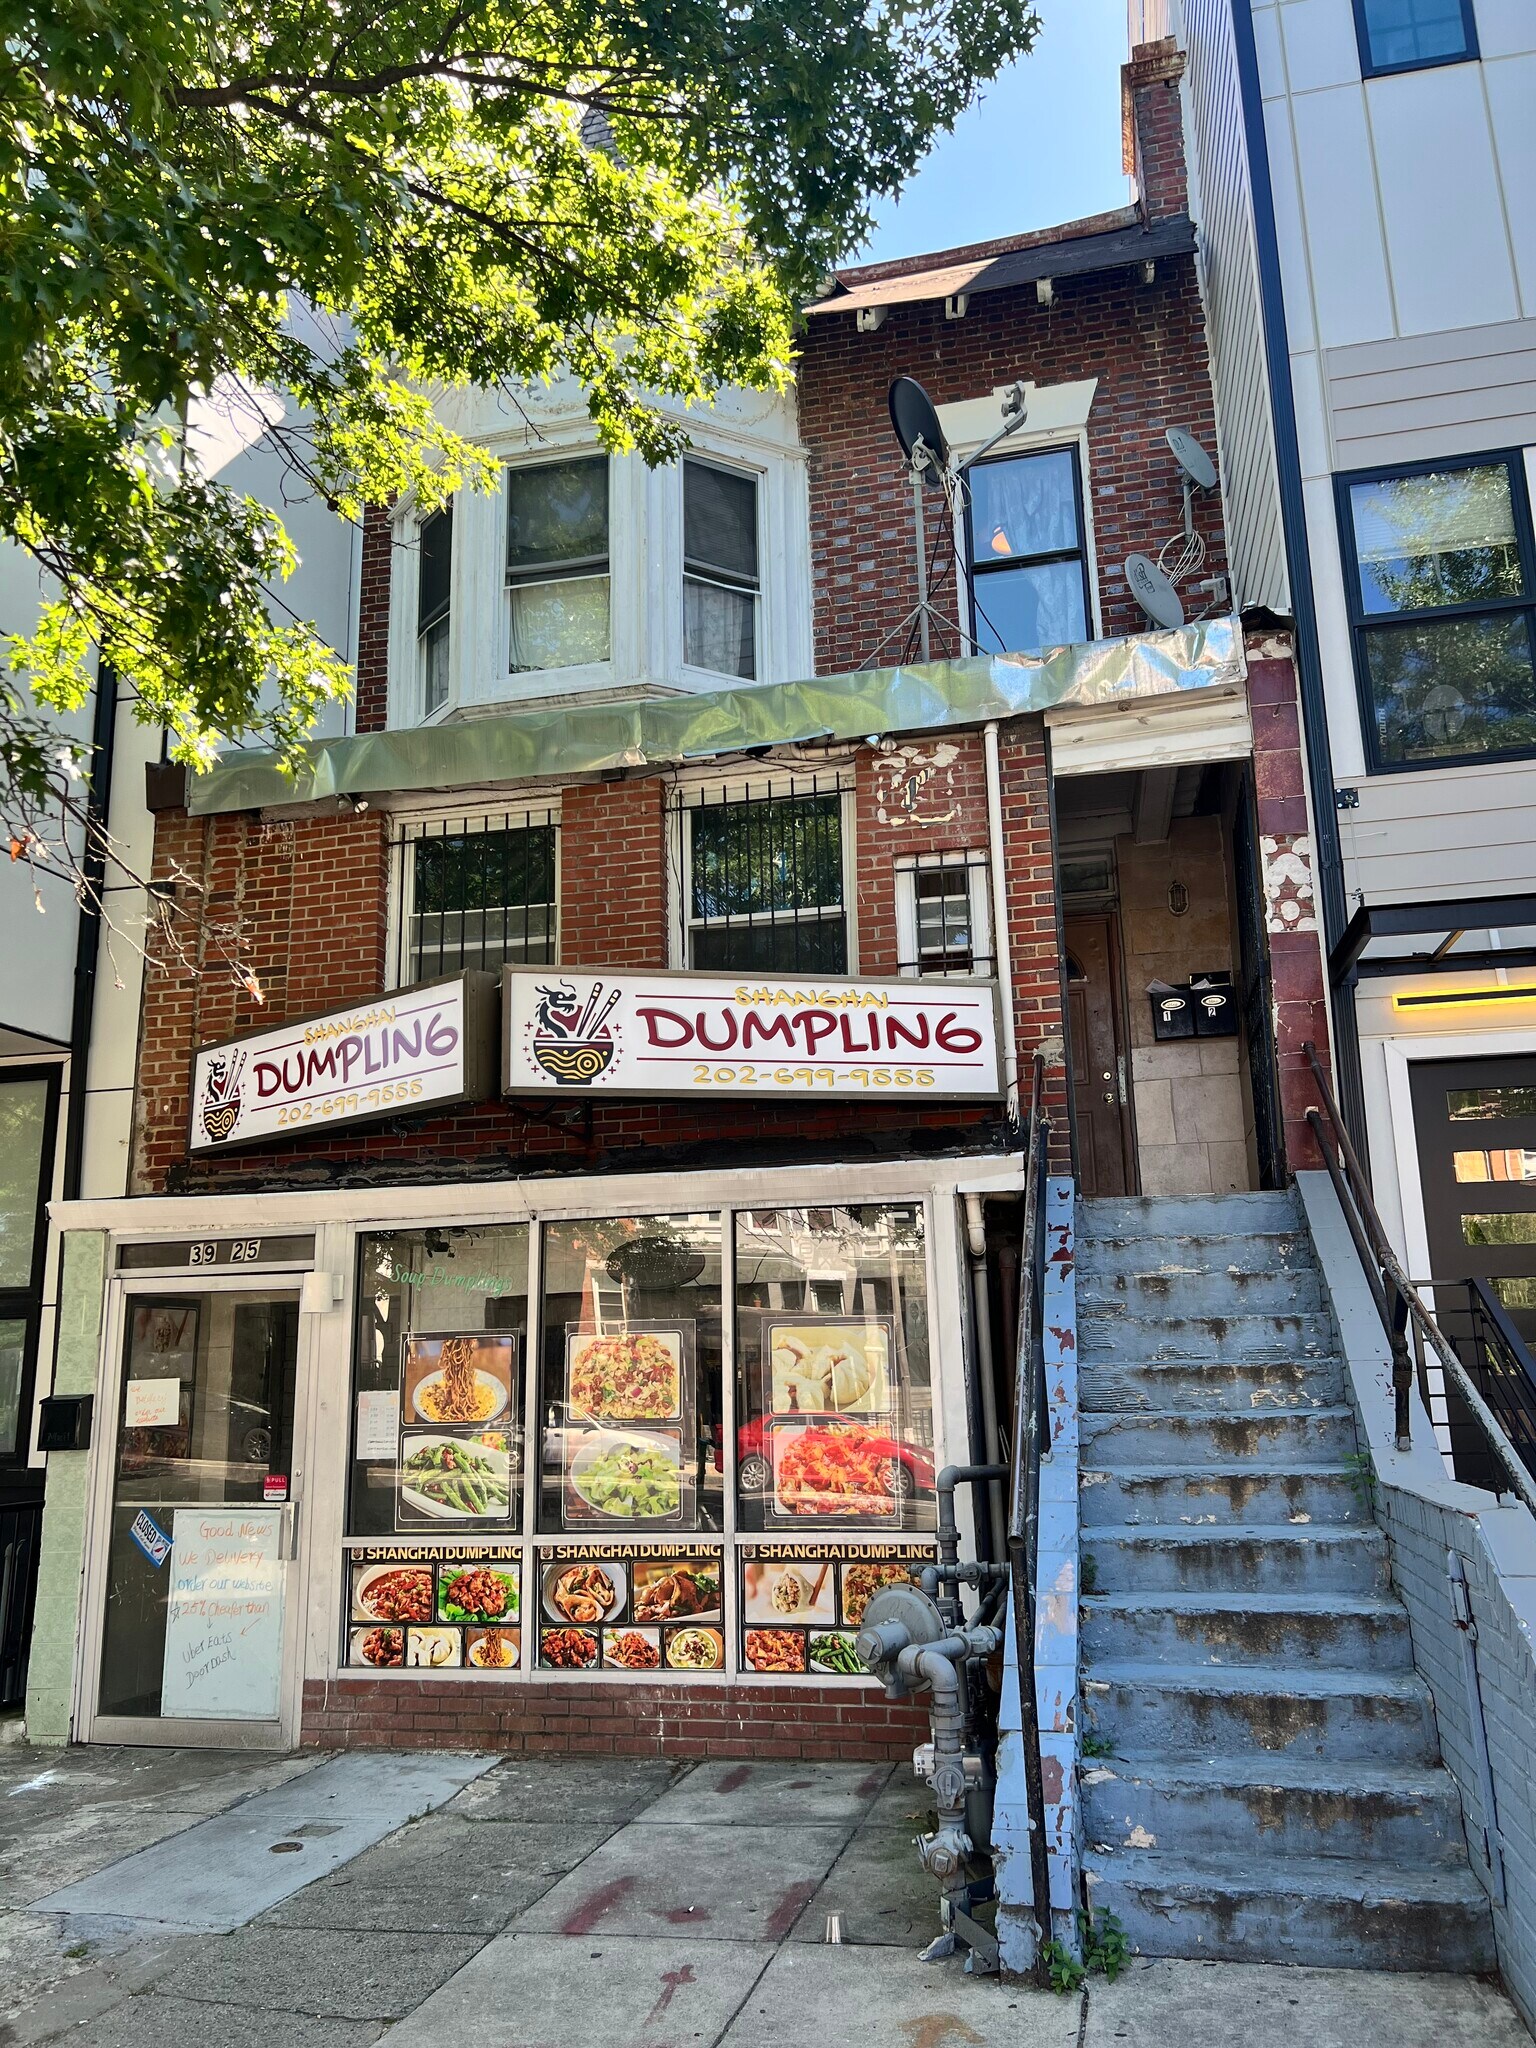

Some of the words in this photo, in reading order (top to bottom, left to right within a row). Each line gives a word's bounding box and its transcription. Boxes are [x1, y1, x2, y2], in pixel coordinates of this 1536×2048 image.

[735, 986, 890, 1010] SHANGHAI
[303, 1005, 397, 1046] SHANGHAI
[635, 1008, 984, 1056] DUMPLING
[253, 1012, 459, 1098] DUMPLING
[191, 1245, 215, 1263] 39
[232, 1241, 259, 1261] 25
[390, 1263, 426, 1290] Soup
[430, 1265, 513, 1299] Dumplings
[137, 1513, 157, 1543] CLOSED
[200, 1521, 234, 1540] Good
[238, 1521, 274, 1538] News
[367, 1546, 444, 1560] SHANGHAI
[445, 1546, 522, 1560] DUMPLING
[557, 1545, 638, 1559] SHANGHAI
[640, 1544, 721, 1557] DUMPLING
[760, 1544, 845, 1559] SHANGHAI
[848, 1544, 934, 1559] DUMPLING
[177, 1574, 207, 1592] order
[209, 1578, 231, 1590] our
[232, 1577, 273, 1592] website
[182, 1600, 206, 1616] 25%
[245, 1601, 270, 1617] than
[182, 1639, 205, 1663] Uber
[208, 1632, 233, 1649] Eats
